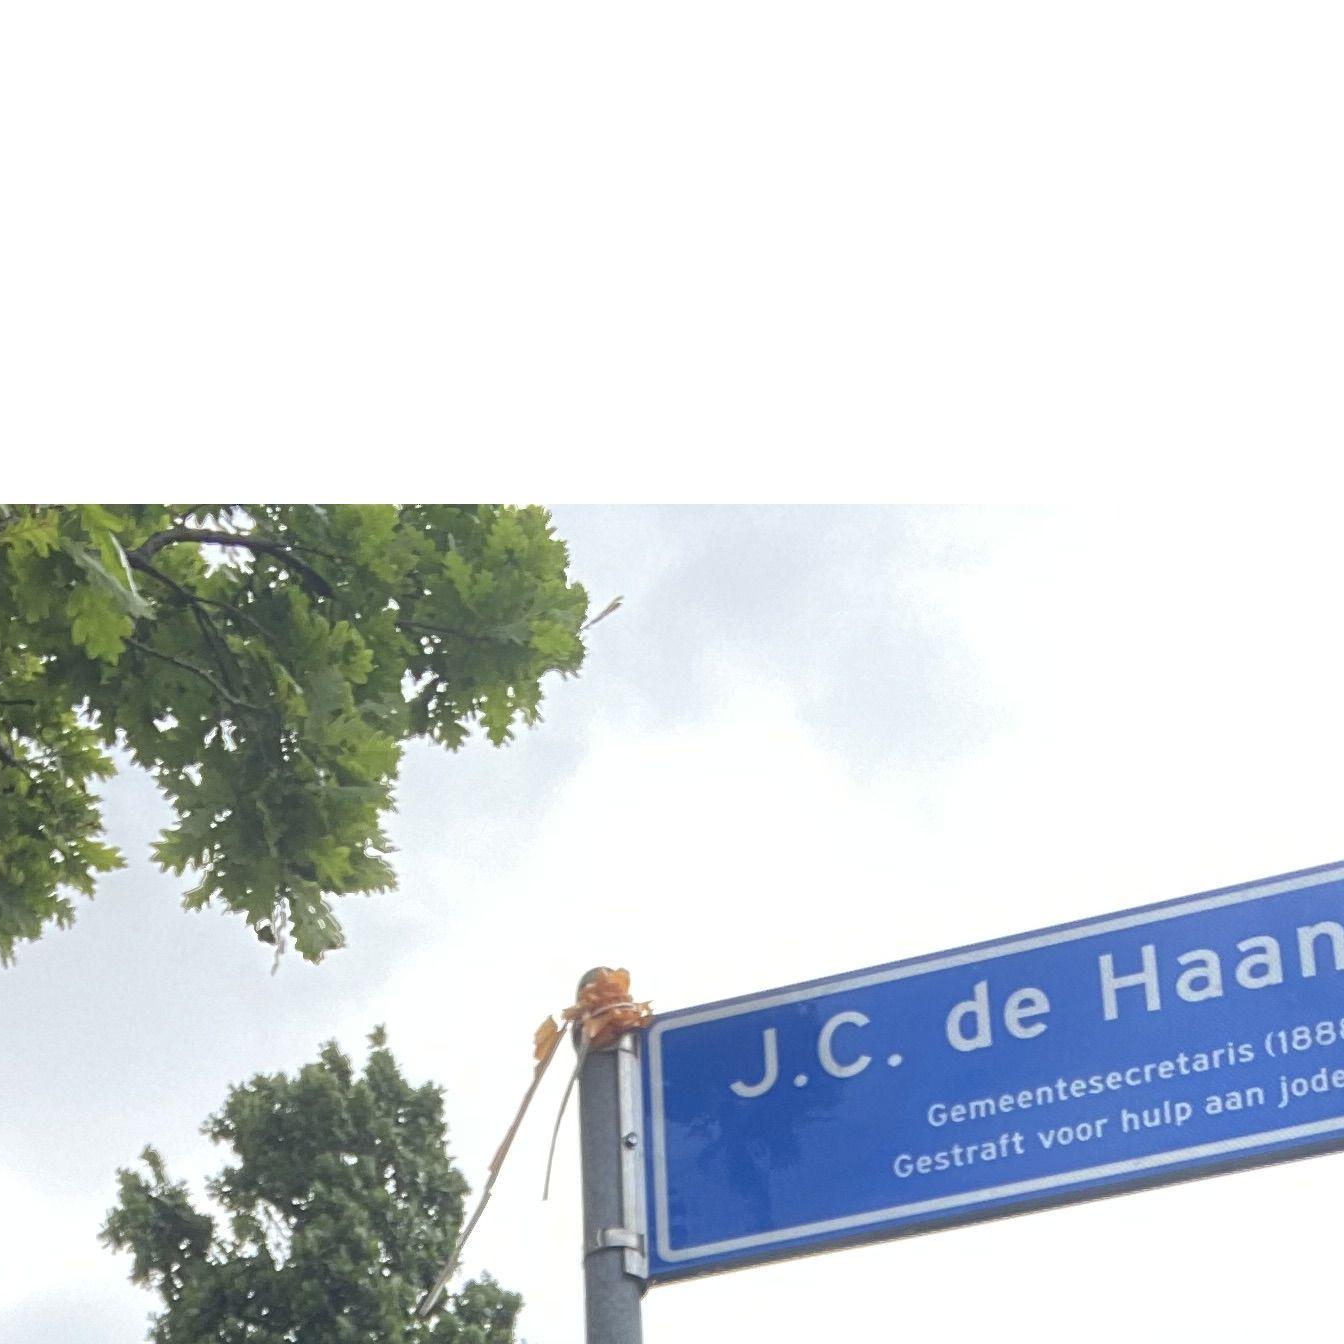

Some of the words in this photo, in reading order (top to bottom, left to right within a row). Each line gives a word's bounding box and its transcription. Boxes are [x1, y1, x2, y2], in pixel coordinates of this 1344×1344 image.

[729, 1010, 903, 1098] J.C.
[945, 979, 1051, 1053] de
[927, 1042, 1256, 1128] Gemeentesecretaris
[893, 1131, 1026, 1179] Gestraft
[1036, 1117, 1109, 1150] voor
[1120, 1099, 1194, 1134] hulp
[1204, 1085, 1266, 1116] aan
